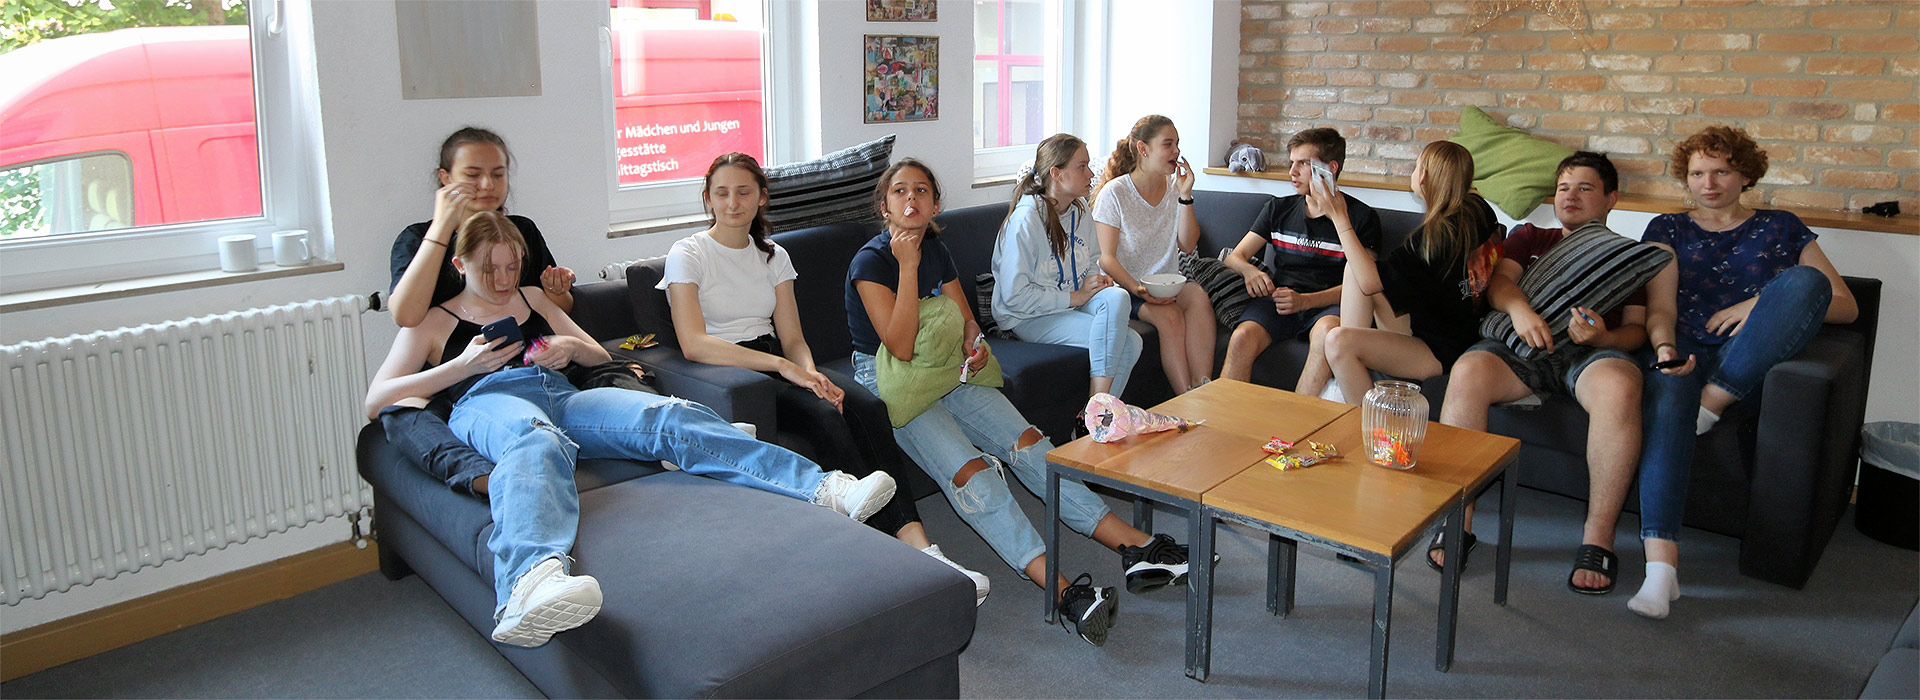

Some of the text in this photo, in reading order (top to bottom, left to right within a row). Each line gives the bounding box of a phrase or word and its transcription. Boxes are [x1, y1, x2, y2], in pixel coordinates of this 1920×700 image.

[625, 123, 678, 139] Mädchen
[680, 120, 700, 136] und
[703, 119, 740, 134] Jungen
[618, 158, 680, 178] ittagstisch
